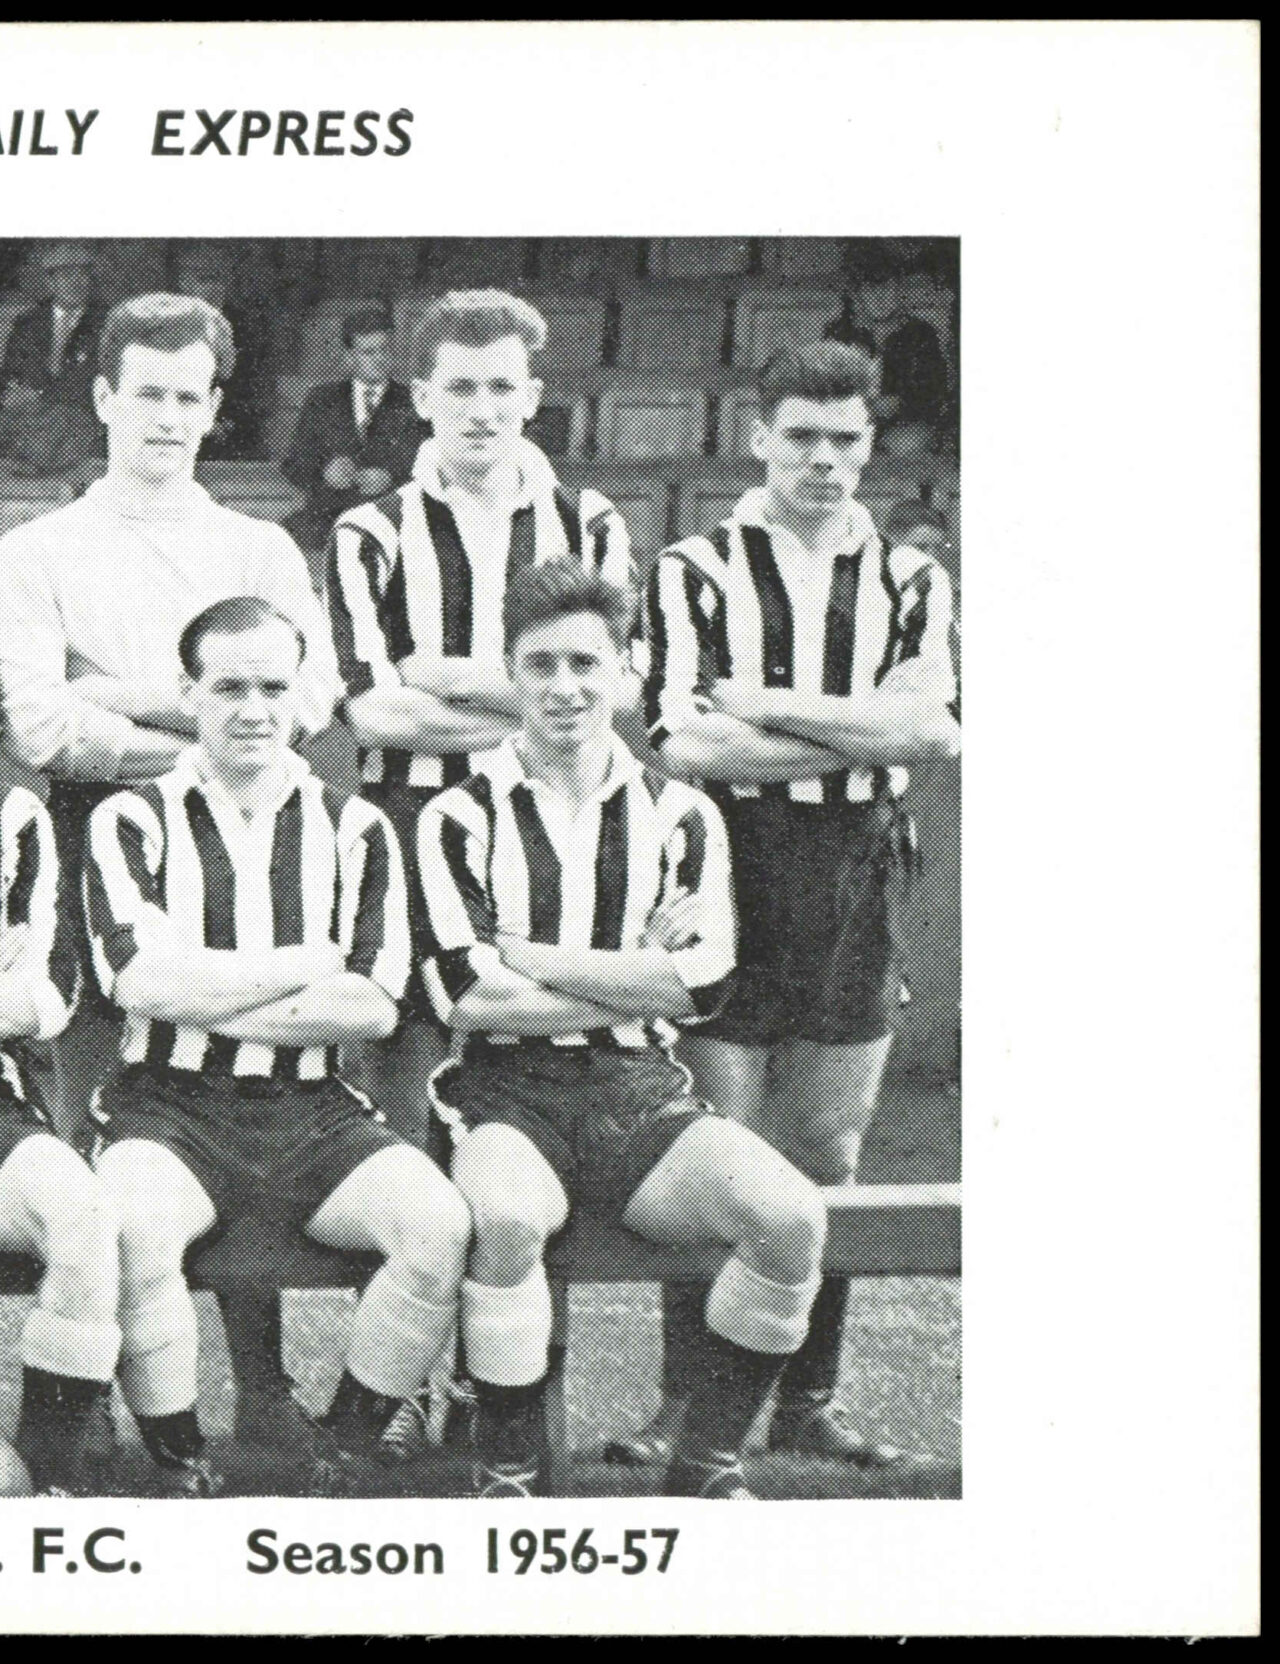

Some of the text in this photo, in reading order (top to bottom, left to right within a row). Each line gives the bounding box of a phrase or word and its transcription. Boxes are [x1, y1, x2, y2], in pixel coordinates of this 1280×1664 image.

[151, 108, 414, 157] EXPRESS
[34, 1527, 141, 1574] F.C.
[248, 1529, 443, 1575] Season
[488, 1528, 679, 1575] 1956-57
